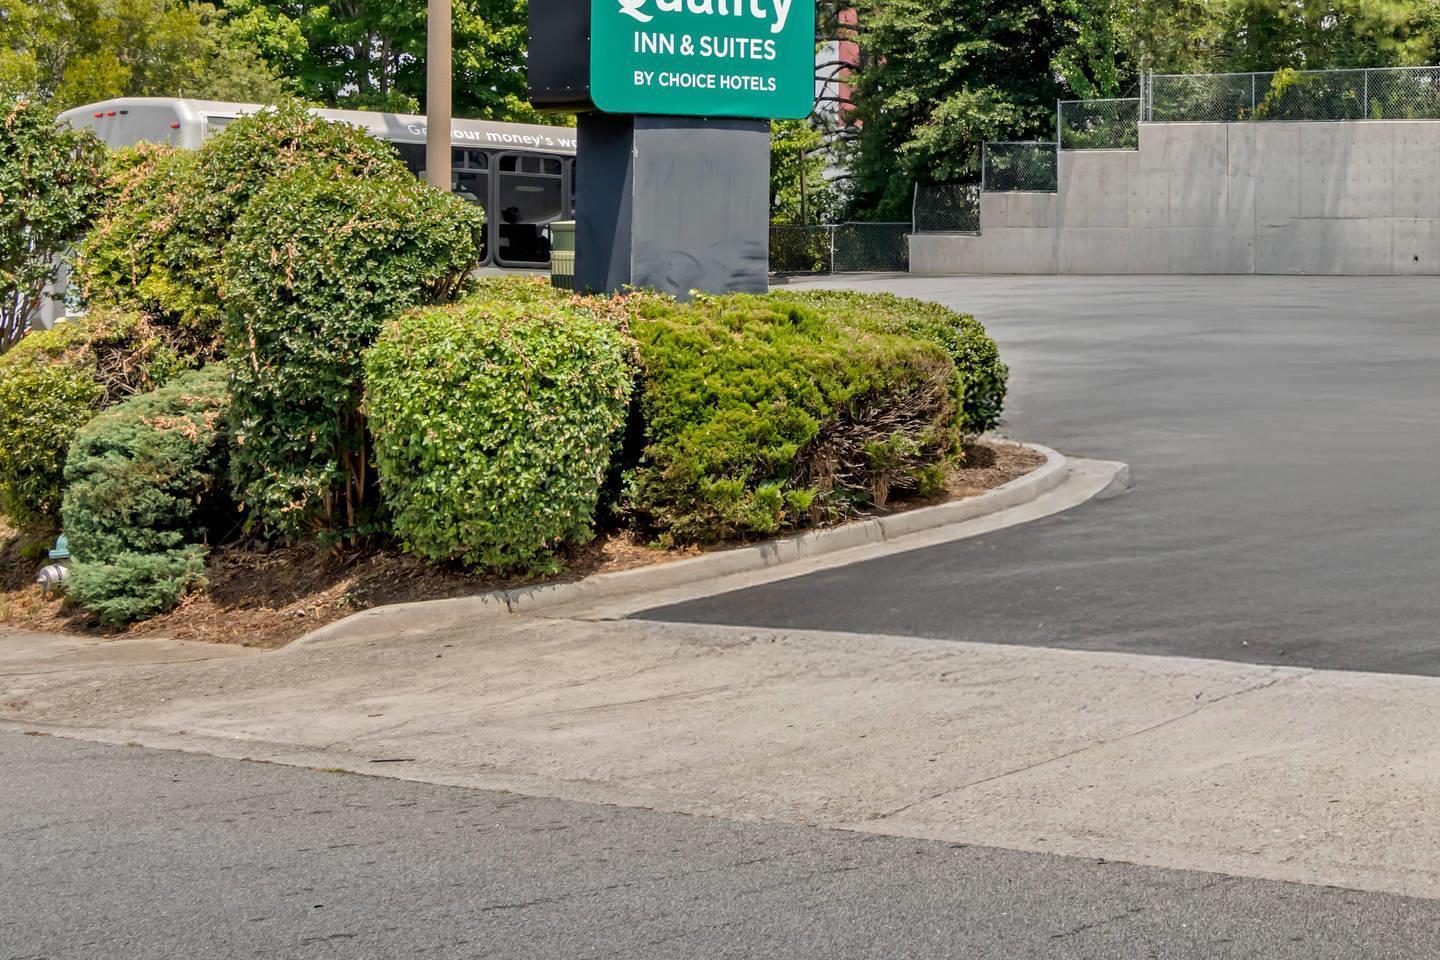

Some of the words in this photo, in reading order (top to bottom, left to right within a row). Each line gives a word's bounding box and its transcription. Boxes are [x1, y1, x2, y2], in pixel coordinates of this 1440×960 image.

[634, 31, 675, 54] INN
[680, 34, 695, 56] &
[699, 35, 776, 60] SUITES
[634, 70, 654, 86] BY
[658, 72, 716, 88] CHOICE
[720, 74, 776, 91] HOTELS
[407, 124, 427, 136] Ge
[453, 129, 480, 141] our
[486, 131, 553, 147] money's
